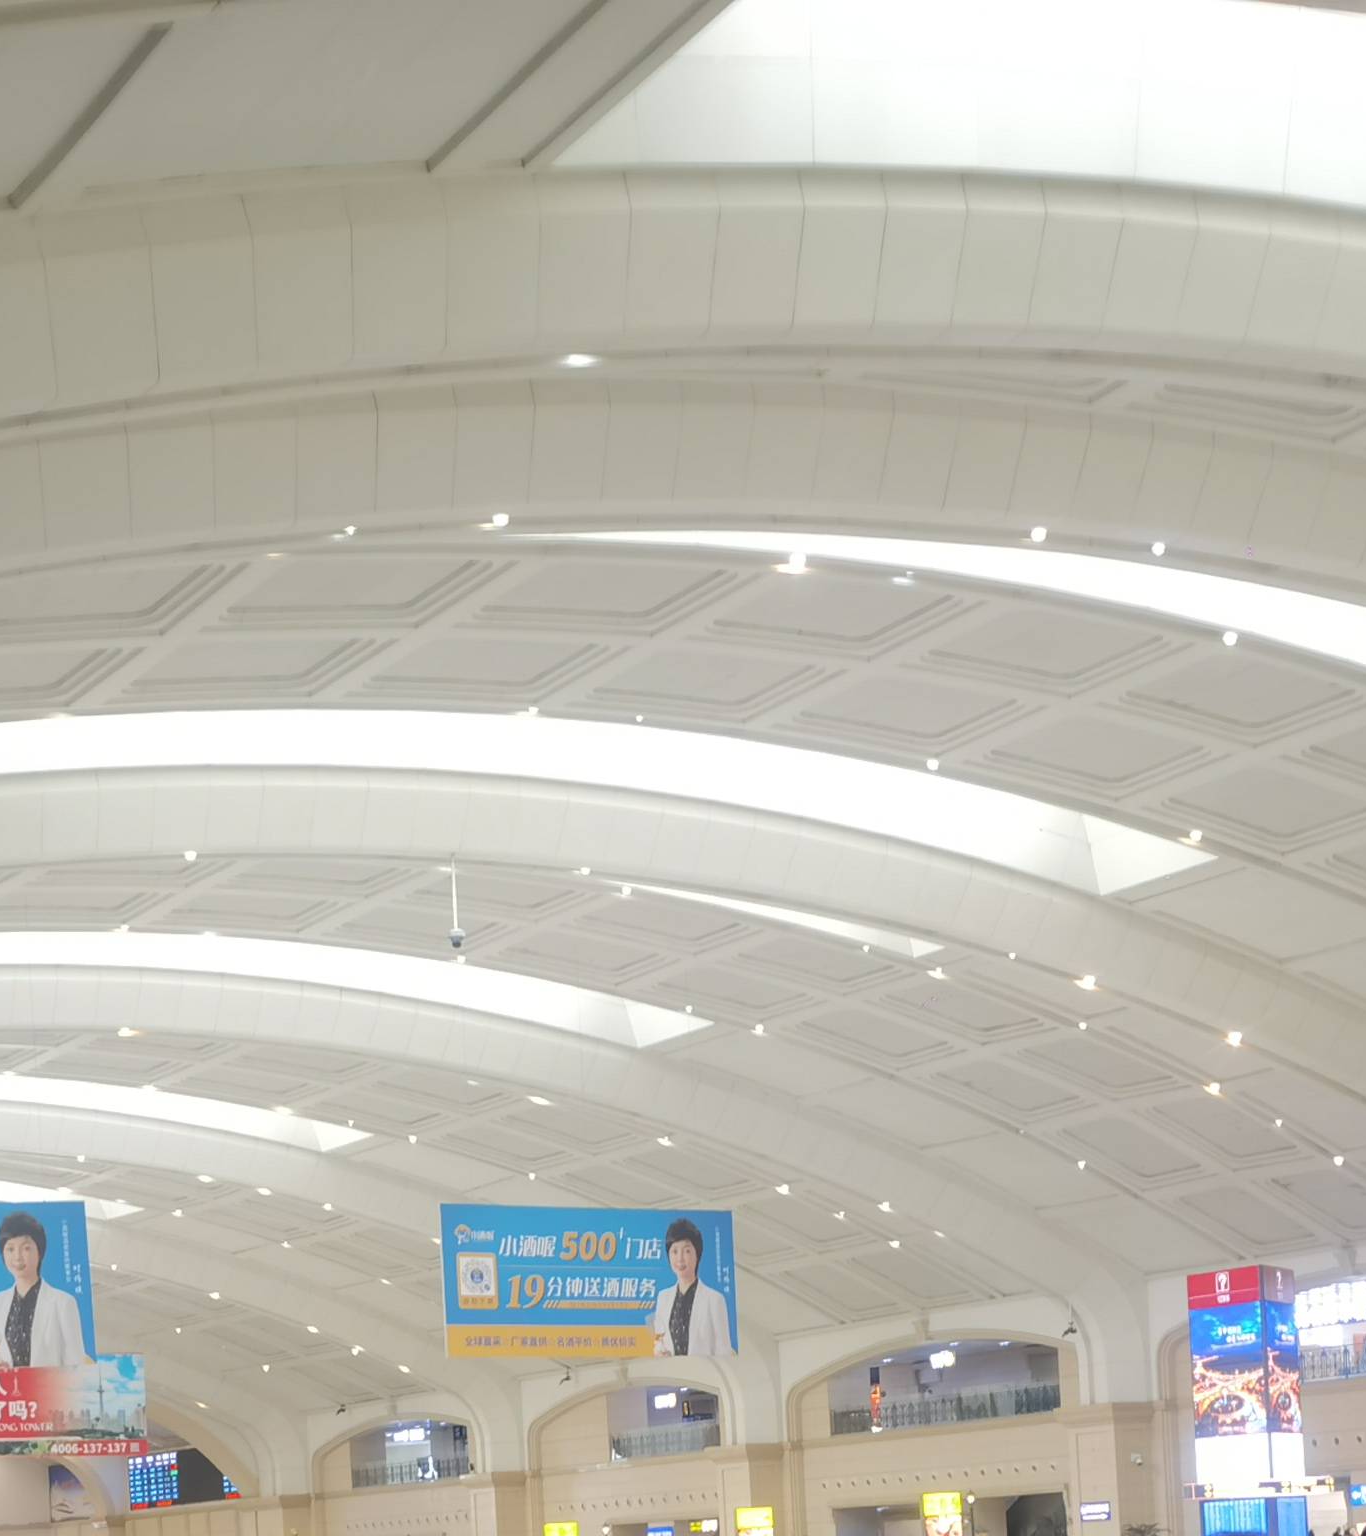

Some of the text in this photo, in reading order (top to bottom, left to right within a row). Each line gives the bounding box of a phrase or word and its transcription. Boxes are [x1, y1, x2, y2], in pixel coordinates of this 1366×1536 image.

[506, 1274, 657, 1310] 19分钟送酒服务
[51, 1442, 127, 1456] 4006-137-137
